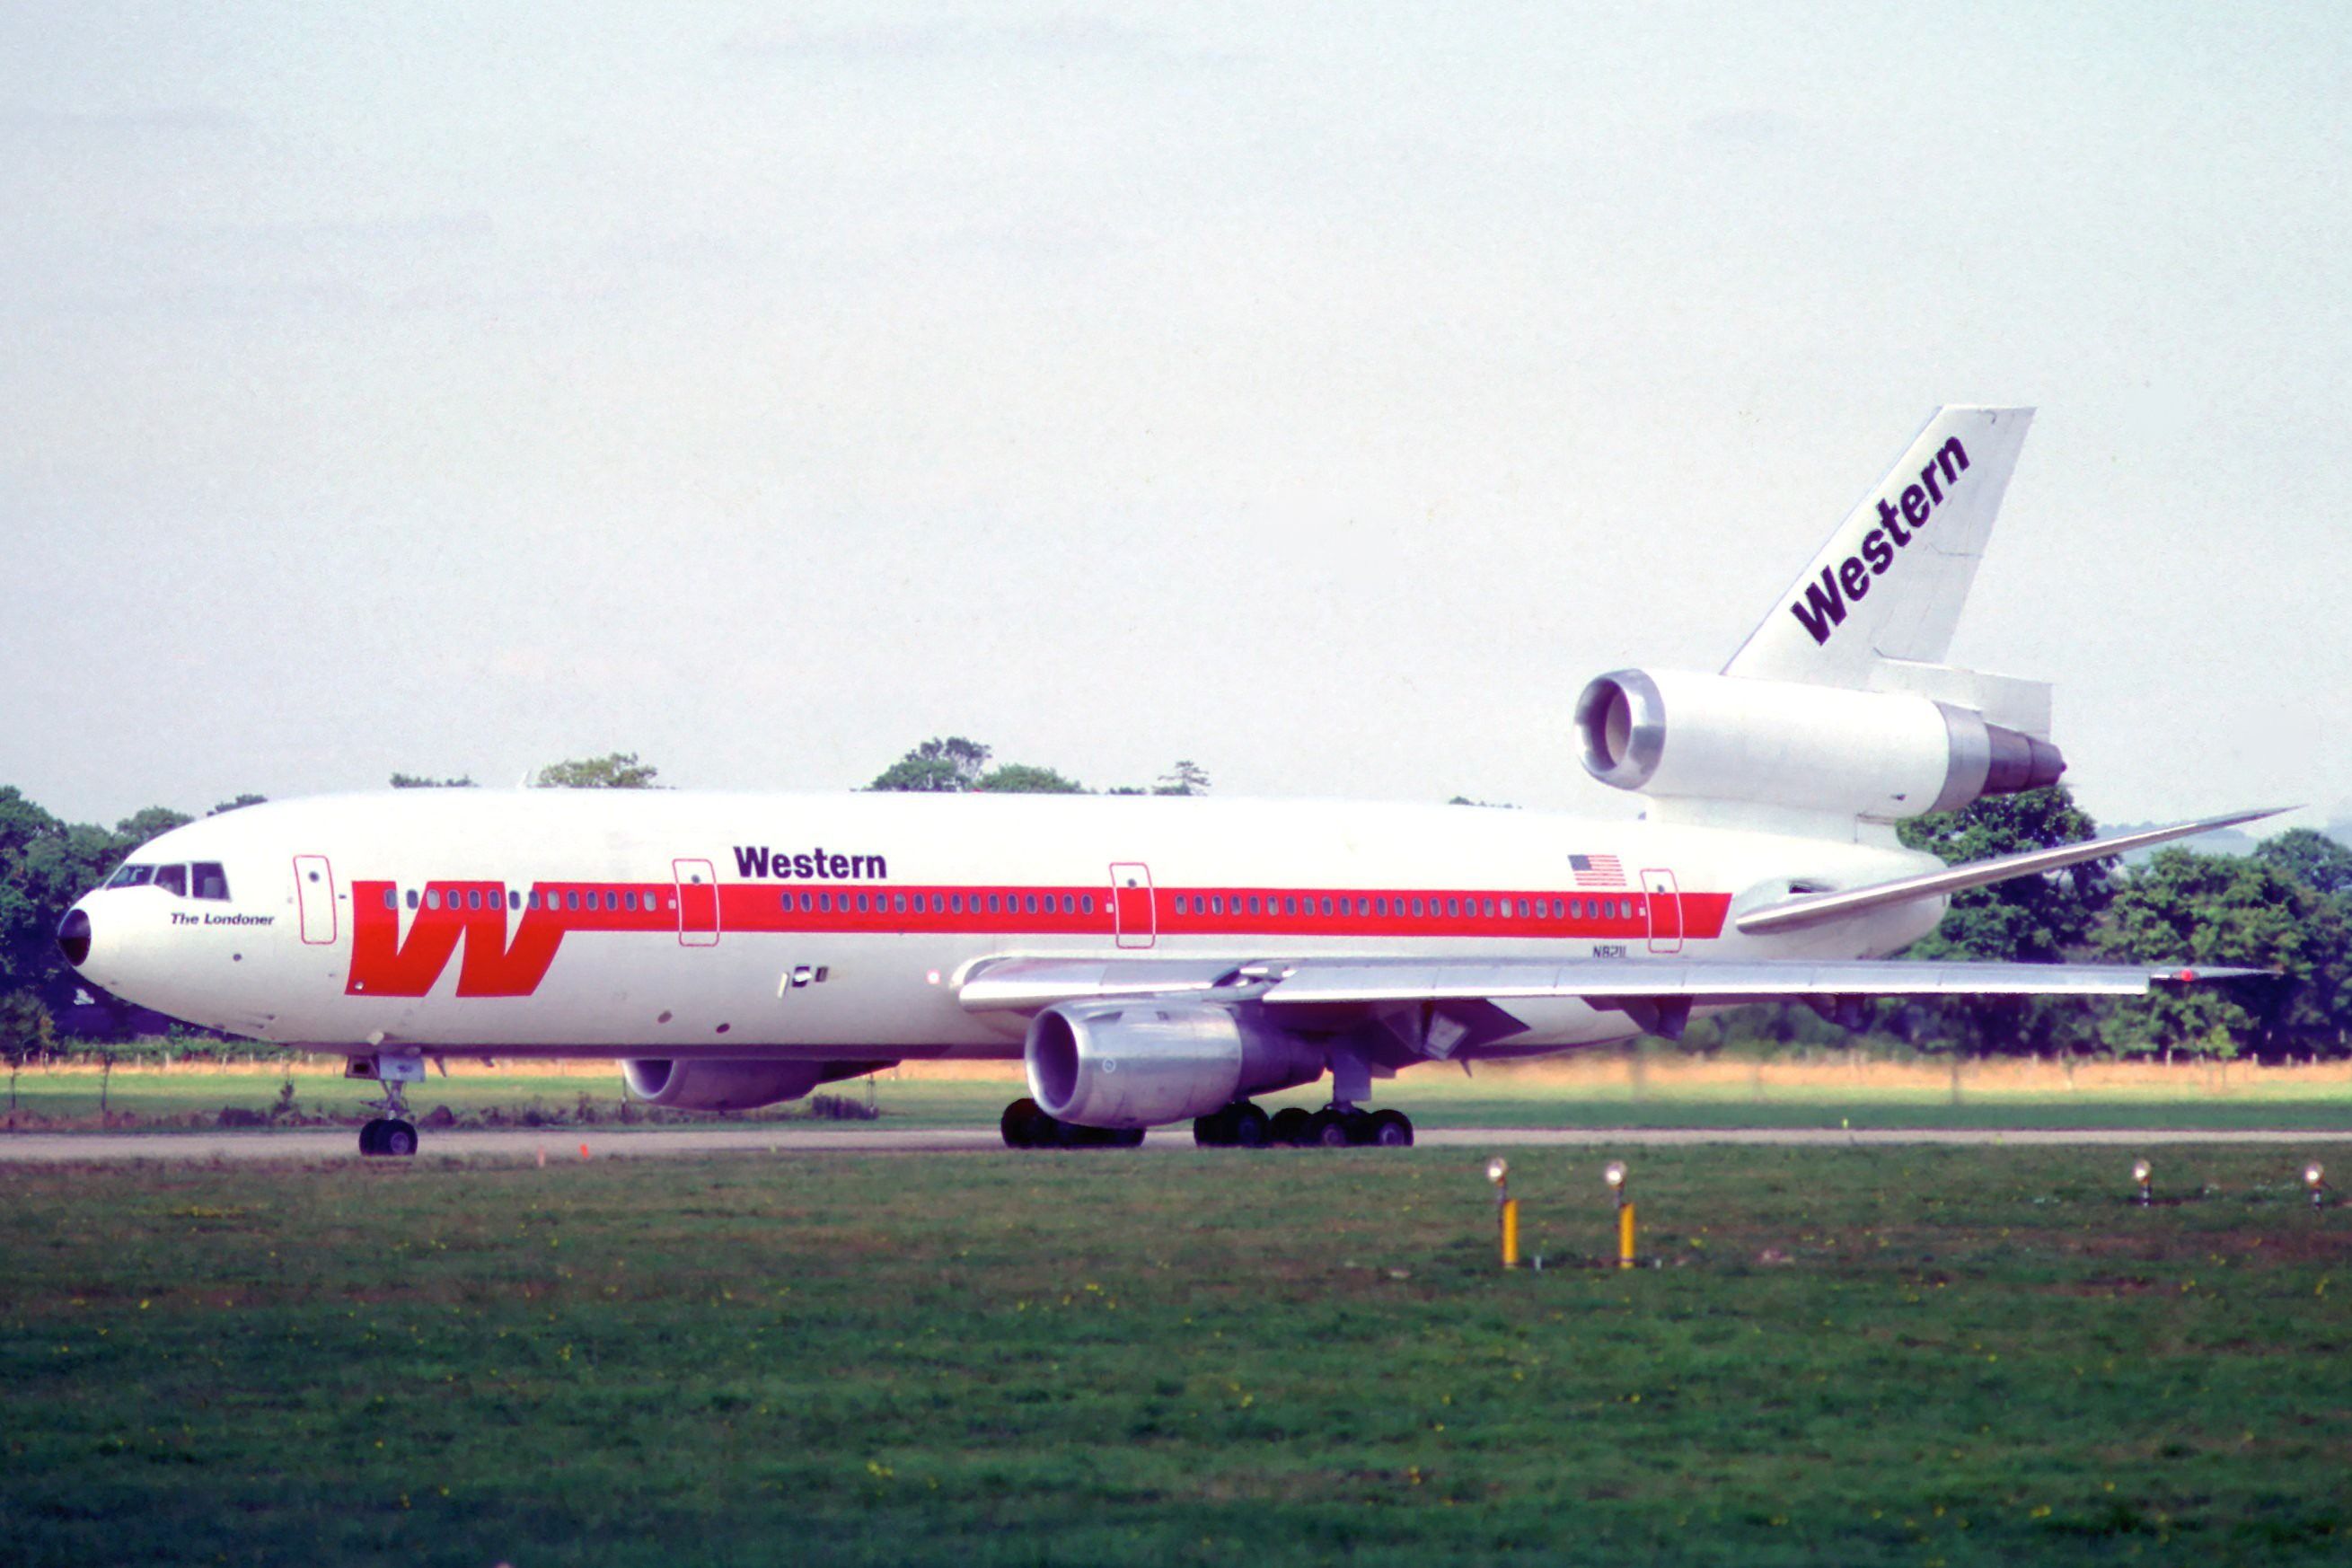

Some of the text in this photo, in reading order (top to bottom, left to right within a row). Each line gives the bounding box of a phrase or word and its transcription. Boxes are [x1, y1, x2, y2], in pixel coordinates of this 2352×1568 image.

[1790, 436, 1970, 647] Western
[733, 846, 887, 879] Western
[171, 912, 275, 925] The Londoner
